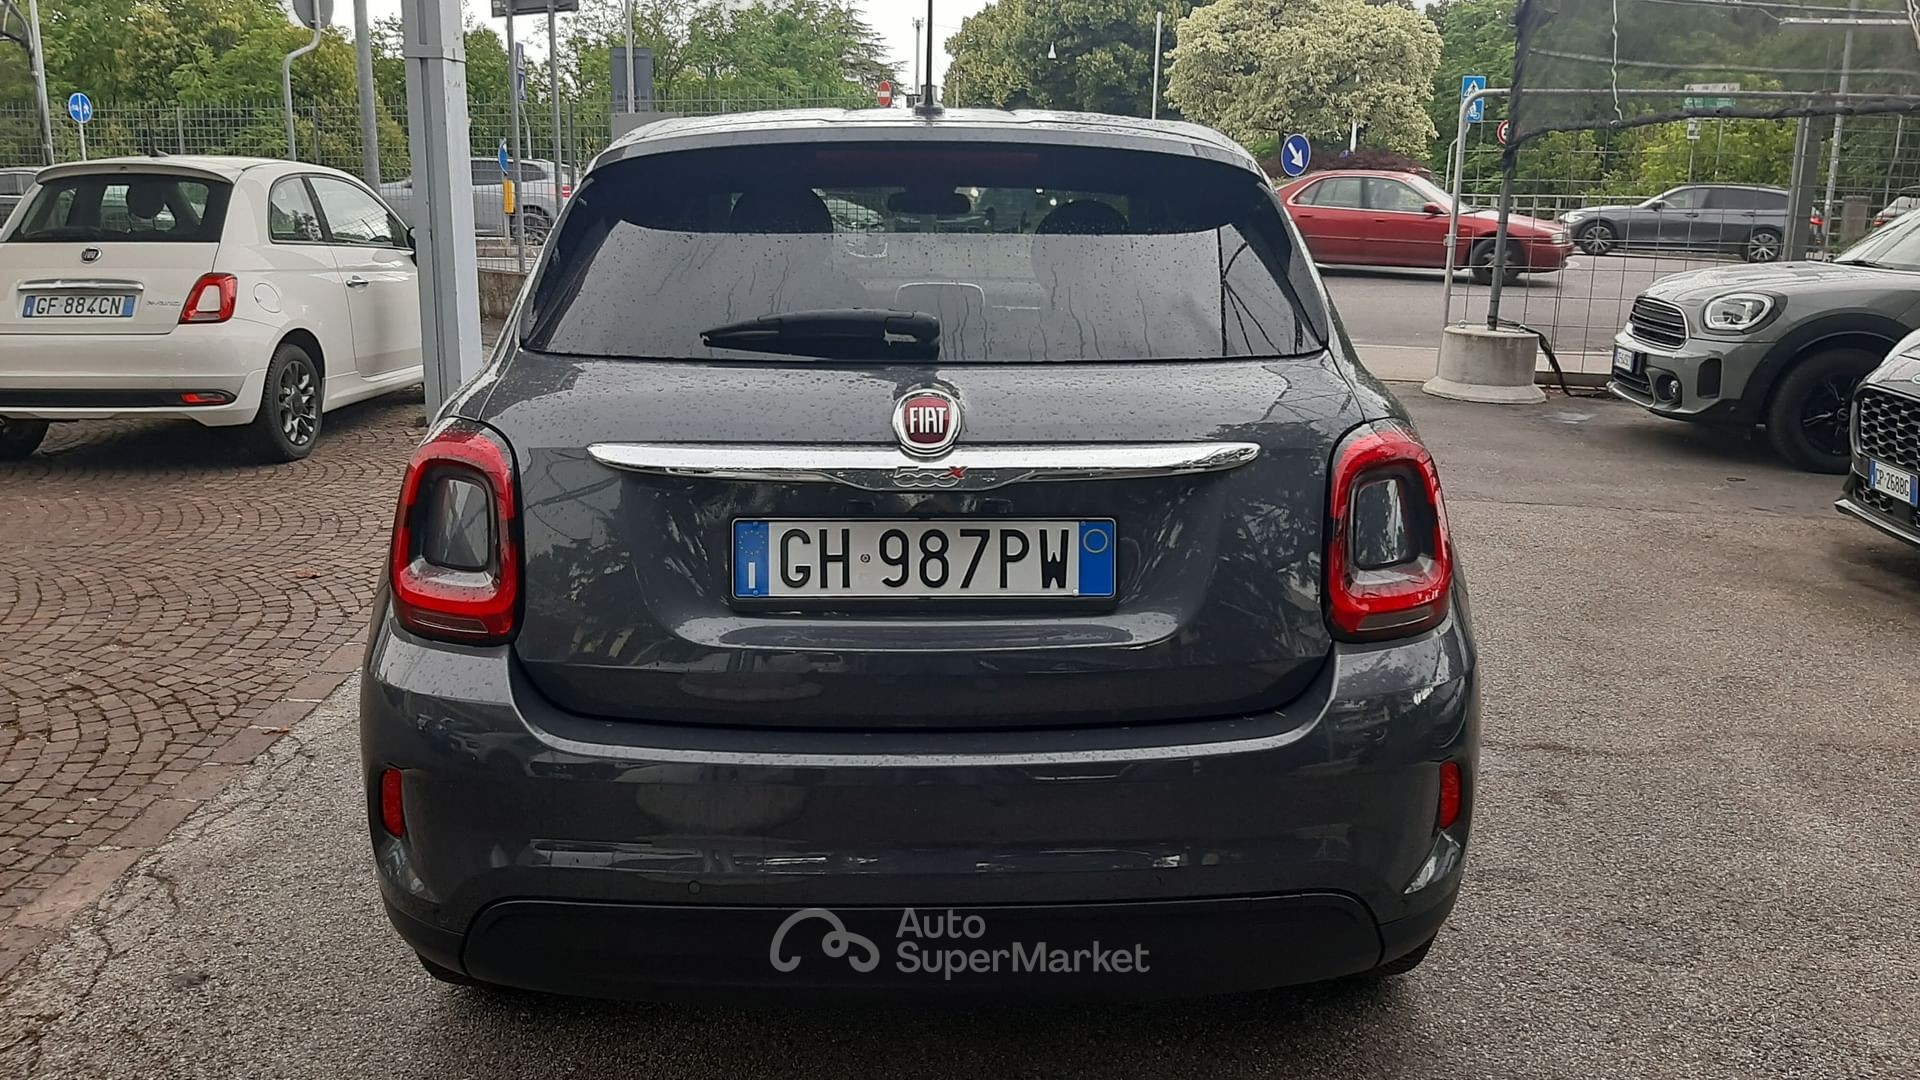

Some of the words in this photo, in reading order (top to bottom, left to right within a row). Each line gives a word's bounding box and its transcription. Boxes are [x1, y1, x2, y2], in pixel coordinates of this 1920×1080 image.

[36, 297, 57, 315] GF
[63, 297, 122, 314] 884CN
[909, 406, 947, 433] FIAT
[779, 528, 851, 589] GH
[878, 528, 1069, 589] 987PW
